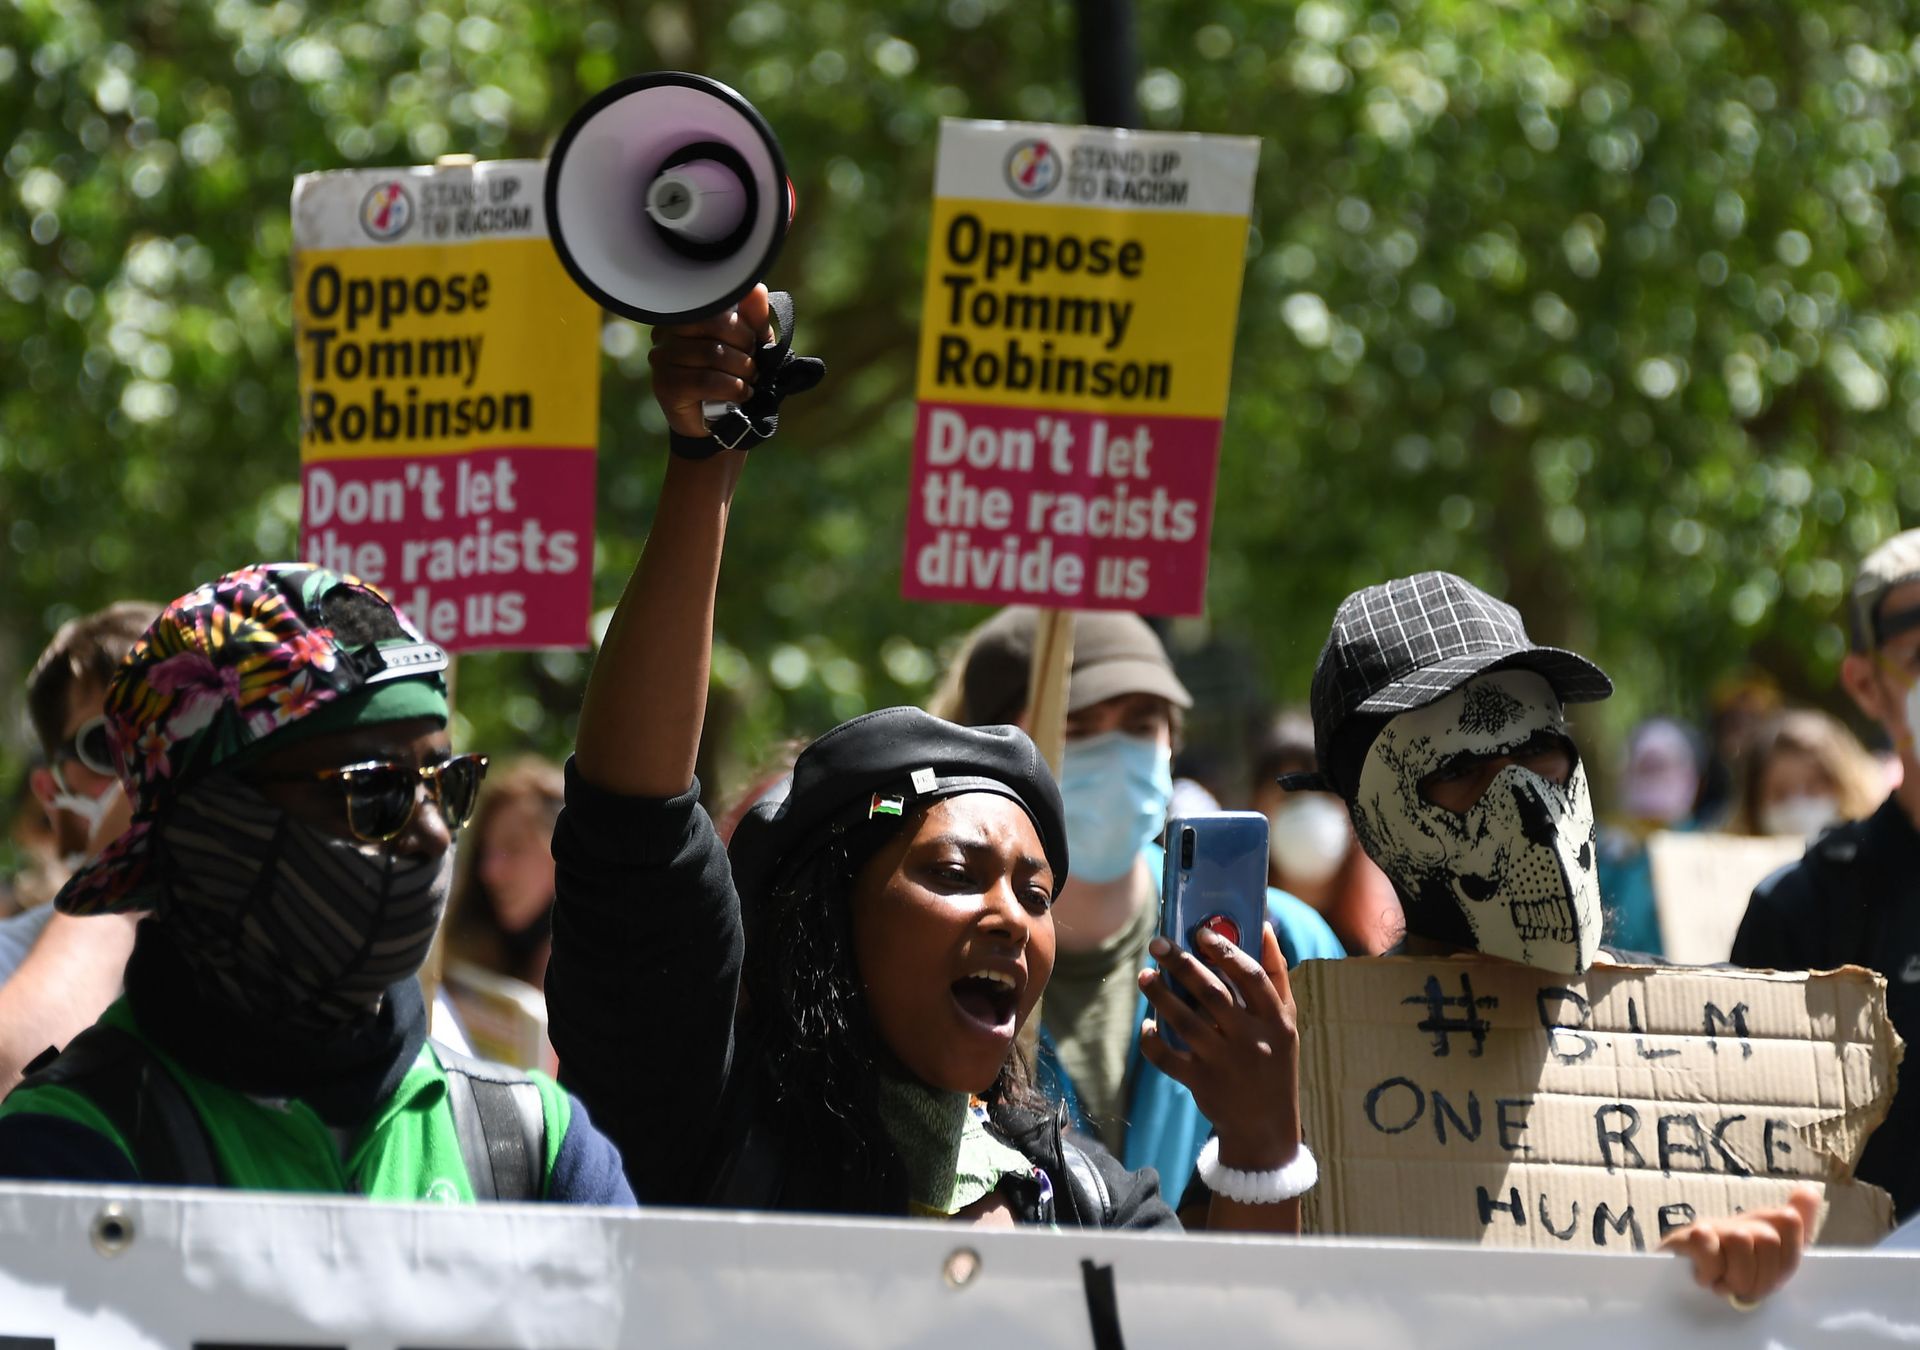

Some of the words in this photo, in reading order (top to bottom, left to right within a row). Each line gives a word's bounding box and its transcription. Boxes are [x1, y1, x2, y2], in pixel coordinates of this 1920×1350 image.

[488, 176, 522, 203] UP
[1068, 175, 1097, 201] TO
[1103, 176, 1189, 207] RACISM
[1070, 146, 1145, 176] STAND
[1149, 151, 1181, 177] UP
[422, 211, 450, 239] TO
[455, 204, 532, 238] RACISM
[945, 213, 1145, 283] Oppose
[306, 265, 490, 330] Oppose
[942, 274, 1134, 350] Tommy
[305, 329, 483, 387] Tommy
[935, 334, 1171, 400] Robinson
[306, 386, 532, 443] Robinson
[926, 408, 1075, 475] Don't
[1088, 419, 1152, 480] let
[307, 463, 443, 527] Don't
[456, 456, 516, 518] let
[922, 471, 1013, 530] the
[1027, 484, 1197, 542] racists
[402, 518, 578, 582] racists
[916, 530, 1085, 597] divide
[1096, 556, 1150, 600] us
[464, 590, 527, 637] us
[1363, 1076, 1535, 1151] ONE
[1594, 1103, 1800, 1178] RACE
